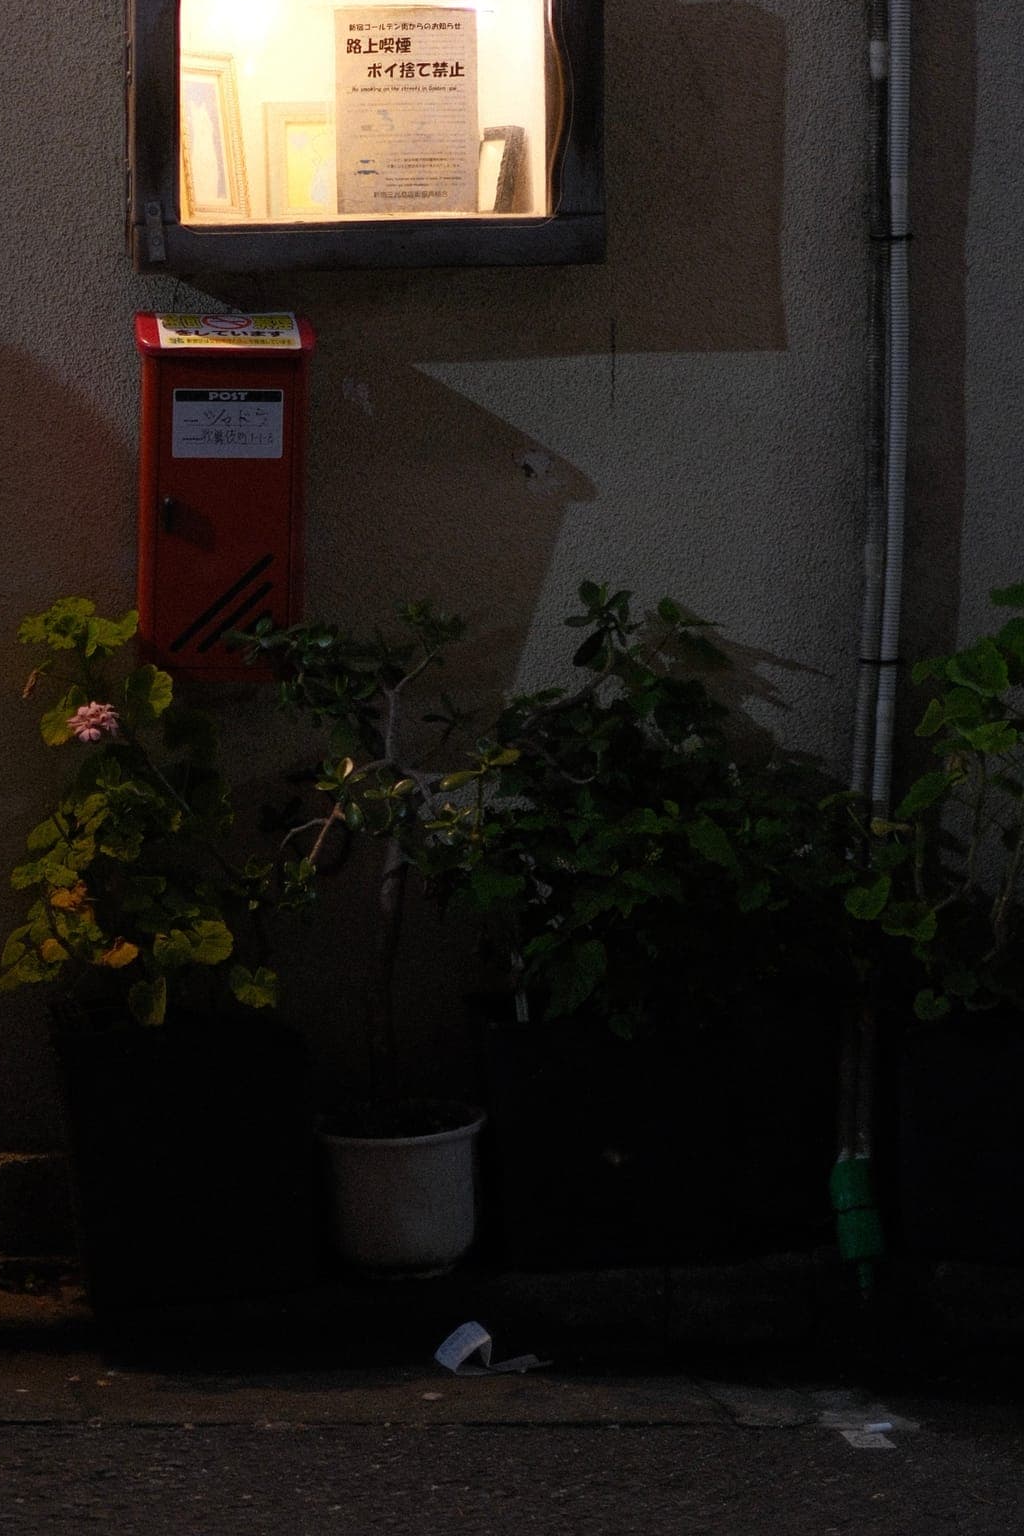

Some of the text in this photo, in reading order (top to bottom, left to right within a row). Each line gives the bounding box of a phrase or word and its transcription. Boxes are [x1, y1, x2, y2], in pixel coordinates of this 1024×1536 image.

[346, 37, 412, 54] 路上喫煙
[367, 61, 466, 78] ポイ捨て禁止
[208, 392, 248, 401] POST
